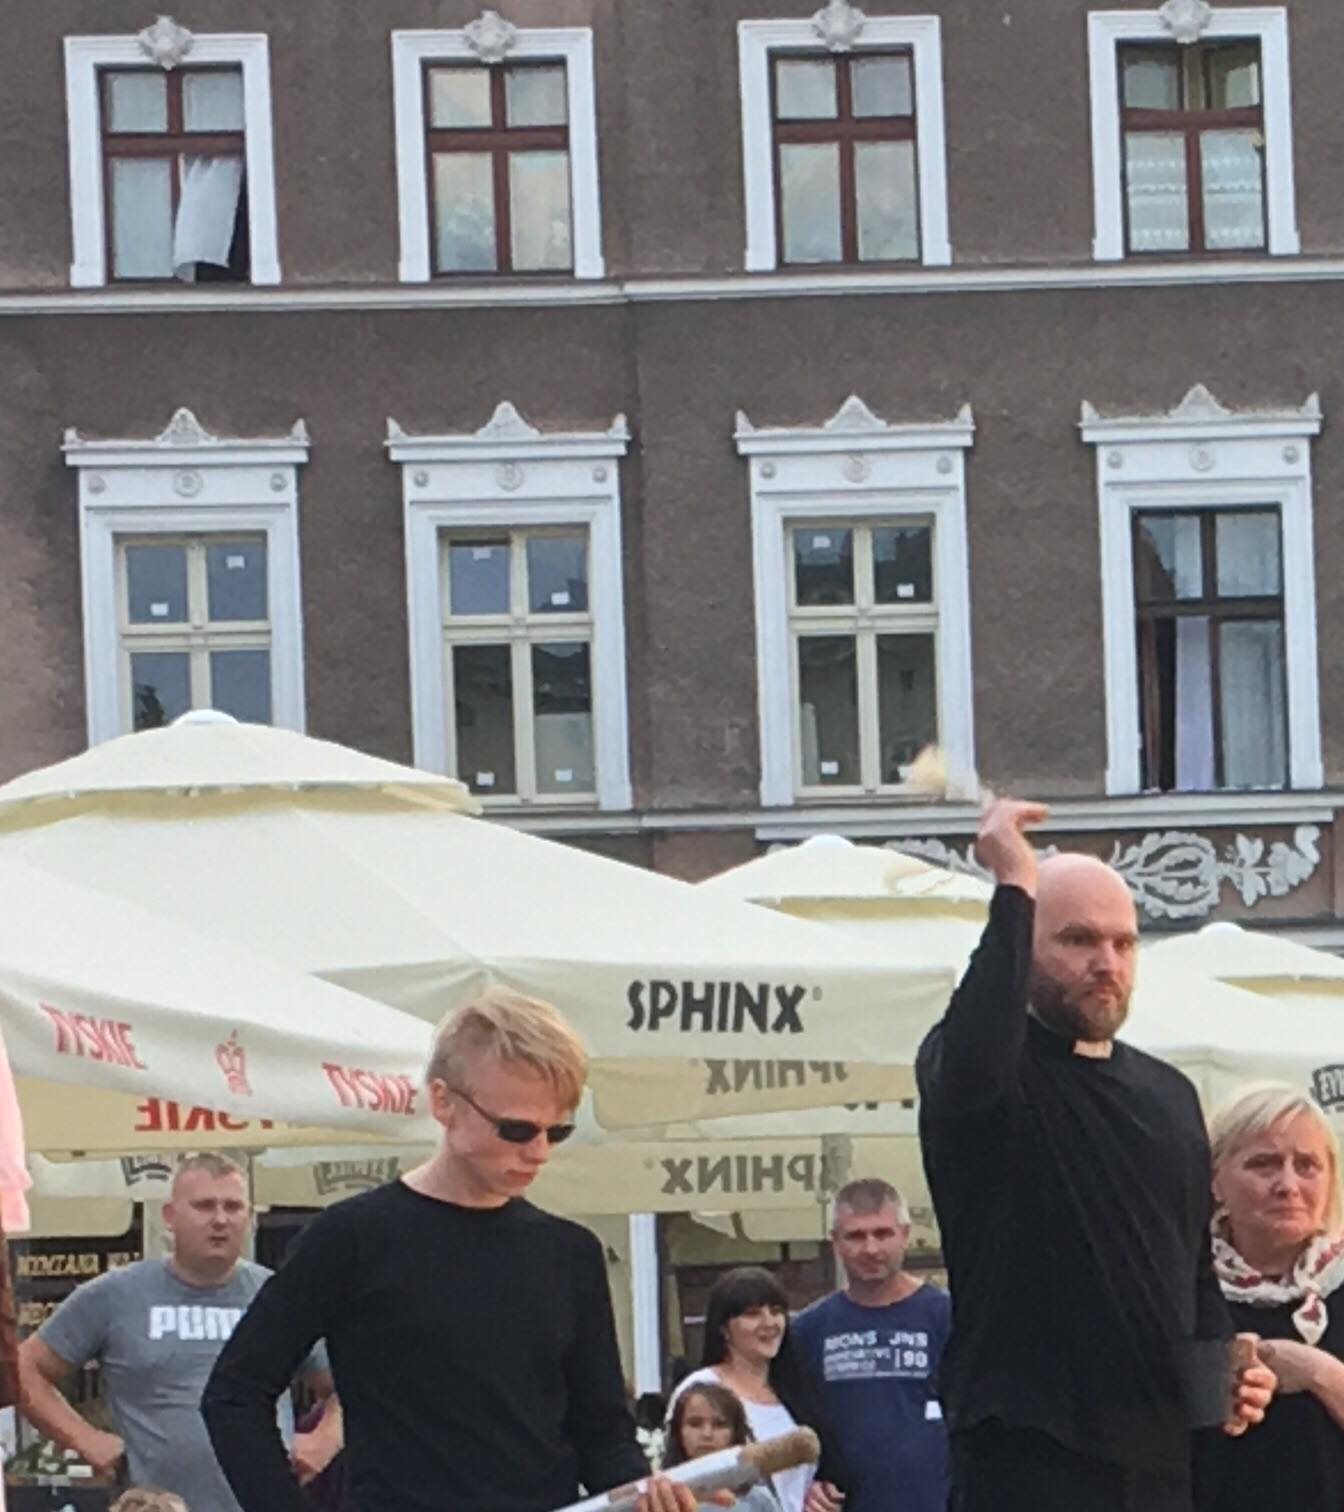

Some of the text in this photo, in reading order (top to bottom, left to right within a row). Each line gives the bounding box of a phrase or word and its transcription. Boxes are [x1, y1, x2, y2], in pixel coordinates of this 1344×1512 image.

[626, 979, 807, 1033] SPHINX
[40, 1001, 147, 1070] TYSKIE
[321, 1062, 418, 1115] TYSKIE
[149, 1304, 243, 1341] PUM
